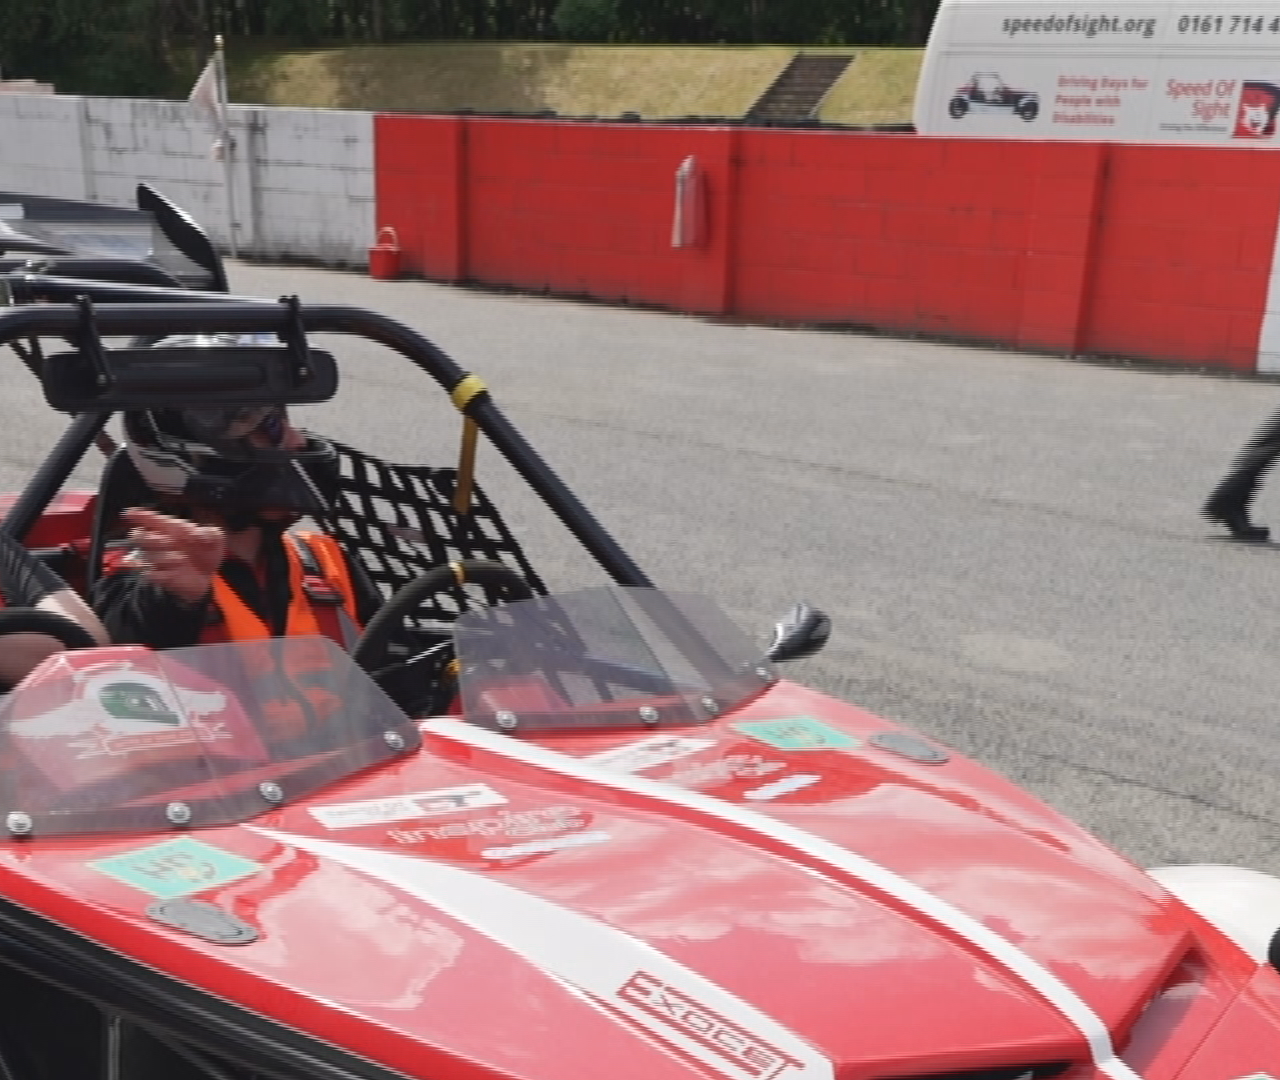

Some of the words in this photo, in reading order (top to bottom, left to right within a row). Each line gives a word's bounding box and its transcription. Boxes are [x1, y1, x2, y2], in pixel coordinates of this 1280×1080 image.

[1002, 15, 1156, 38] speedofsight.org
[1178, 16, 1223, 34] 0161
[1229, 16, 1263, 34] 714
[1166, 79, 1212, 101] Speed
[1215, 80, 1236, 97] Of
[1192, 101, 1231, 122] Sight
